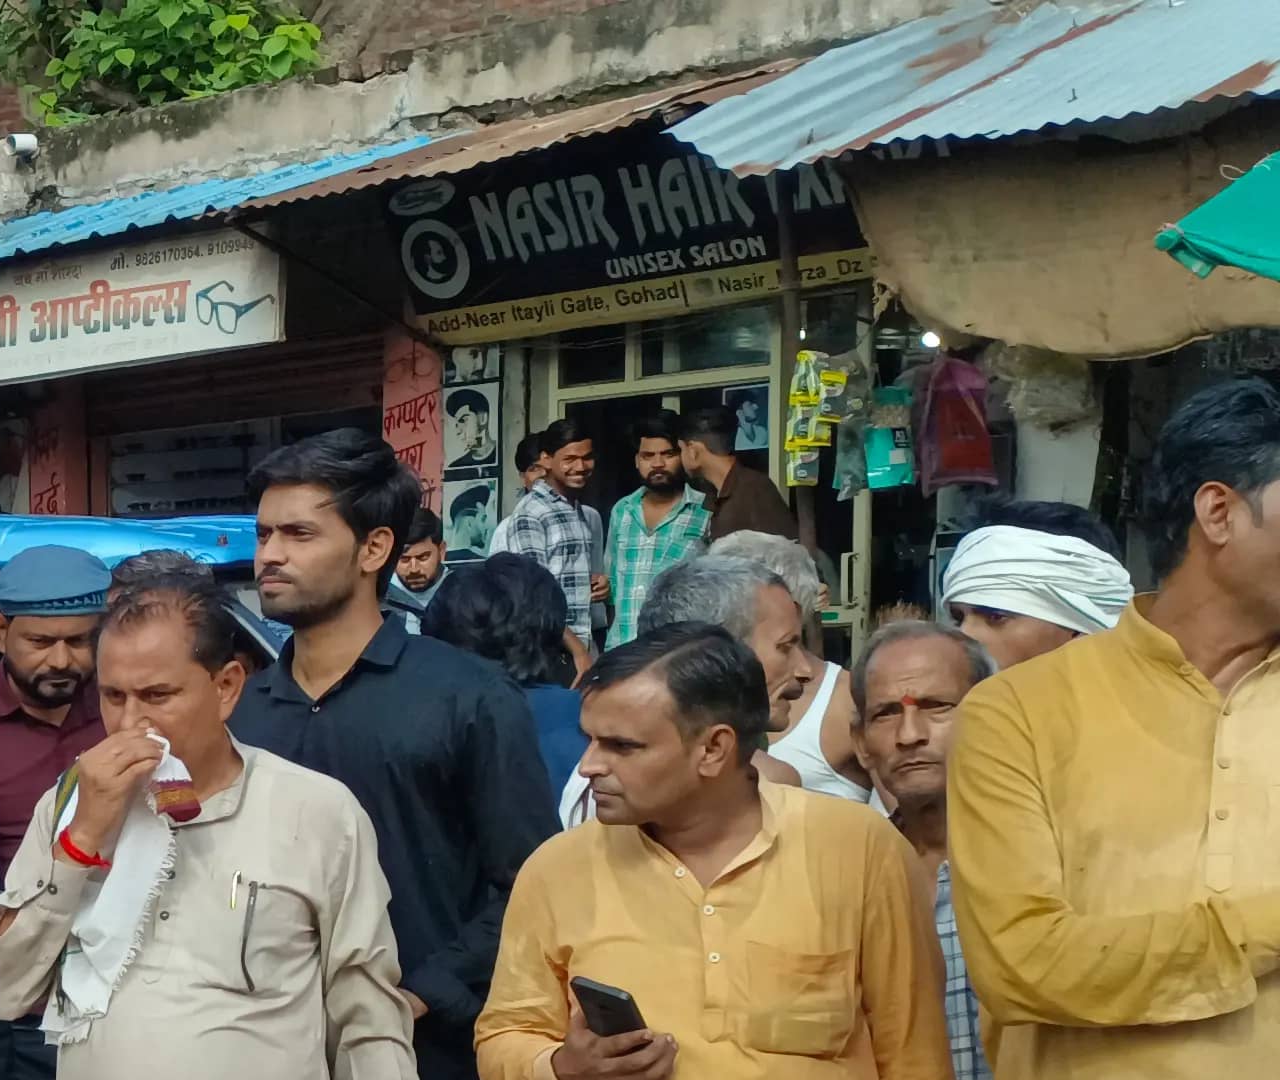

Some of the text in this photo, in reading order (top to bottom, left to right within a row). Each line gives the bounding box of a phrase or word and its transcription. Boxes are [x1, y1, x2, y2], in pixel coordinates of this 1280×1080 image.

[468, 173, 621, 263] NASIR
[605, 235, 767, 280] UNISEX SALON
